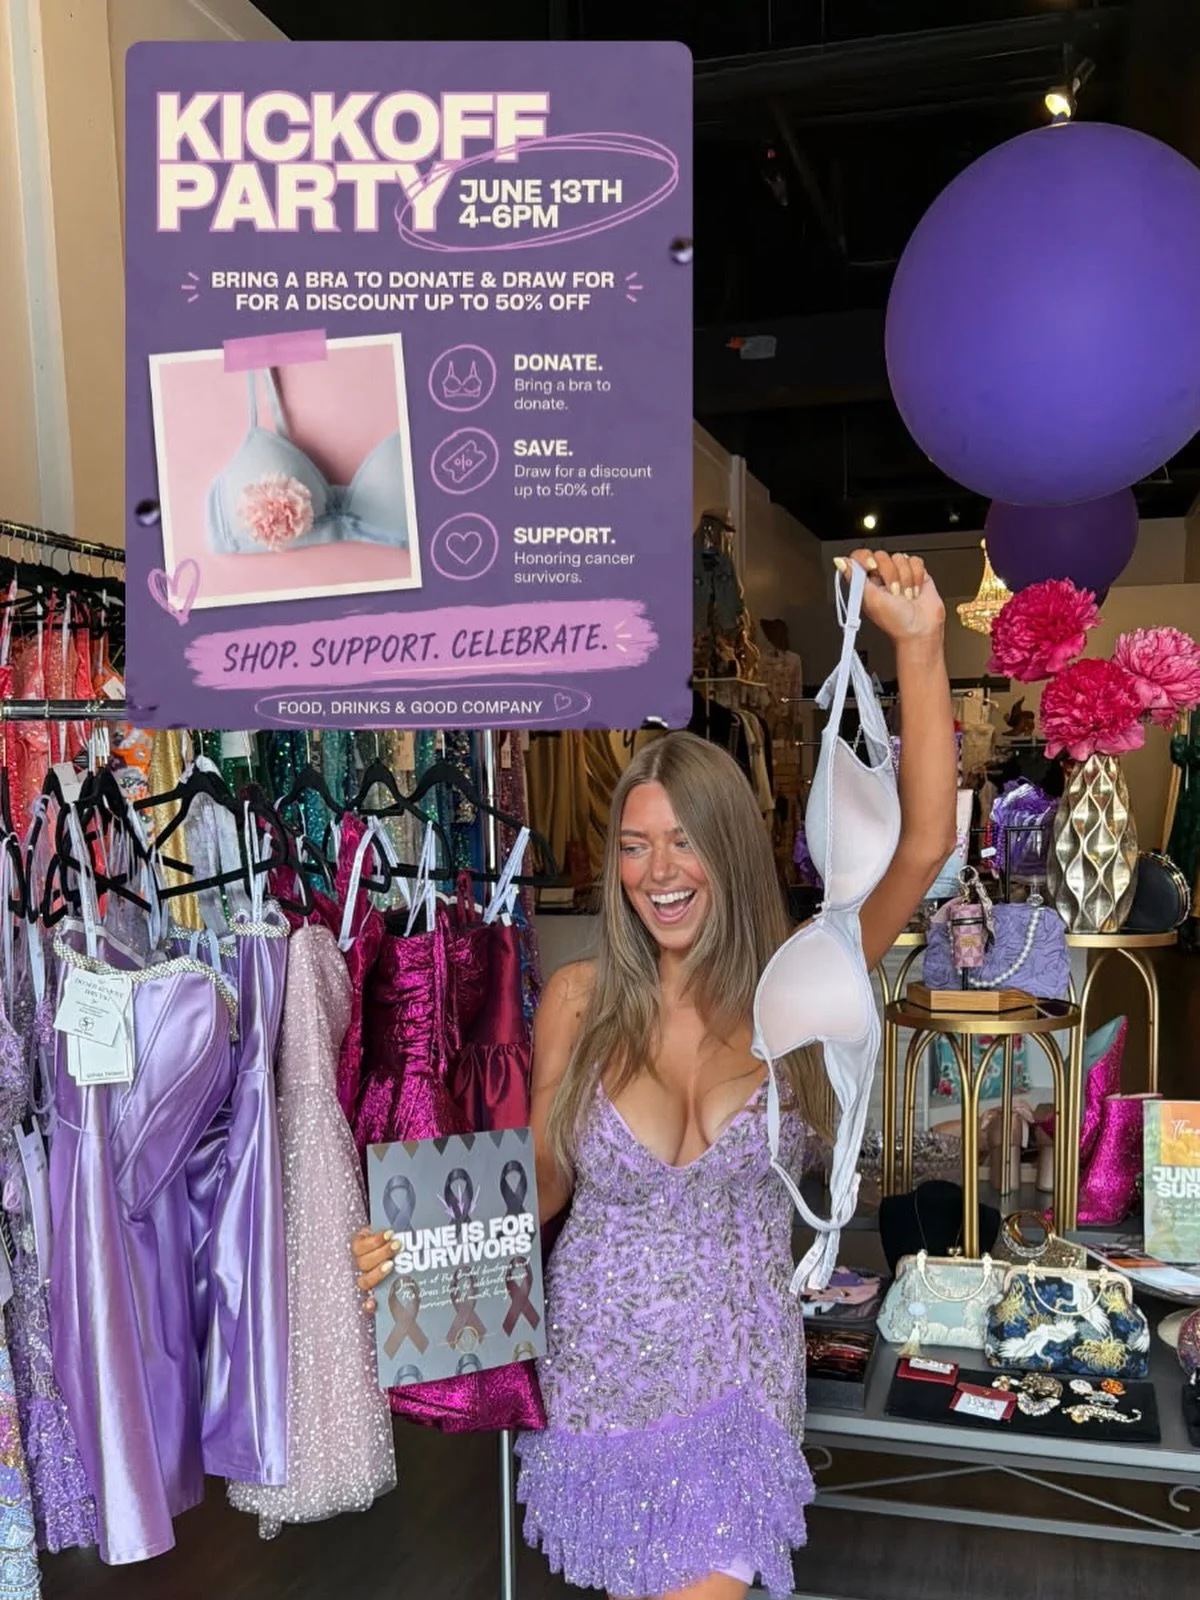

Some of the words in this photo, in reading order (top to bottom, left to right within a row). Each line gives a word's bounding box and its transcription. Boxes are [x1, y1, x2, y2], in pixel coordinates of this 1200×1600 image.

[158, 91, 549, 163] KICKOFF
[158, 162, 454, 231] PARTY
[459, 179, 542, 203] JUNE
[550, 179, 622, 203] 13TH
[459, 205, 558, 228] 4-6PM
[211, 271, 278, 289] BRING
[284, 271, 299, 289] A
[305, 271, 348, 289] BRA
[354, 271, 382, 289] TO
[389, 271, 474, 289] DONATE
[480, 271, 496, 289] &
[502, 271, 567, 289] DRAW
[573, 271, 614, 289] FOR
[236, 293, 279, 311] FOR
[284, 293, 299, 311] A
[306, 293, 419, 311] DISCOUNT
[425, 293, 454, 311] UP
[459, 293, 488, 311] TO
[495, 293, 543, 311] 50%
[549, 293, 590, 311] OFF
[514, 353, 603, 372] DONATE.
[514, 377, 552, 395] Bring
[556, 380, 565, 391] a
[568, 378, 593, 392] bra
[597, 379, 611, 392] to
[514, 396, 568, 411] donate.
[514, 440, 573, 457] SAVE.
[514, 464, 551, 478] Draw
[555, 464, 574, 478] for
[577, 467, 587, 478] a
[590, 464, 652, 478] discount
[514, 486, 533, 499] up
[536, 483, 551, 497] to
[554, 482, 588, 497] 50%
[592, 482, 614, 497] off.
[514, 527, 616, 545] SUPPORT.
[514, 551, 581, 568] Honoring
[584, 554, 635, 565] cancer
[514, 570, 582, 584] survivors.
[223, 640, 299, 673] SHOP.
[310, 632, 439, 667] SUPPORT.
[451, 623, 608, 659] CELEBRATE.
[278, 700, 326, 717] FOOD,
[331, 700, 390, 714] DRINKS
[394, 700, 406, 714] &
[410, 700, 458, 714] GOOD
[462, 700, 543, 714] COMPANY
[461, 1221, 484, 1243] IS
[489, 1213, 534, 1239] FOR
[394, 1233, 532, 1274] SURVIVORS
